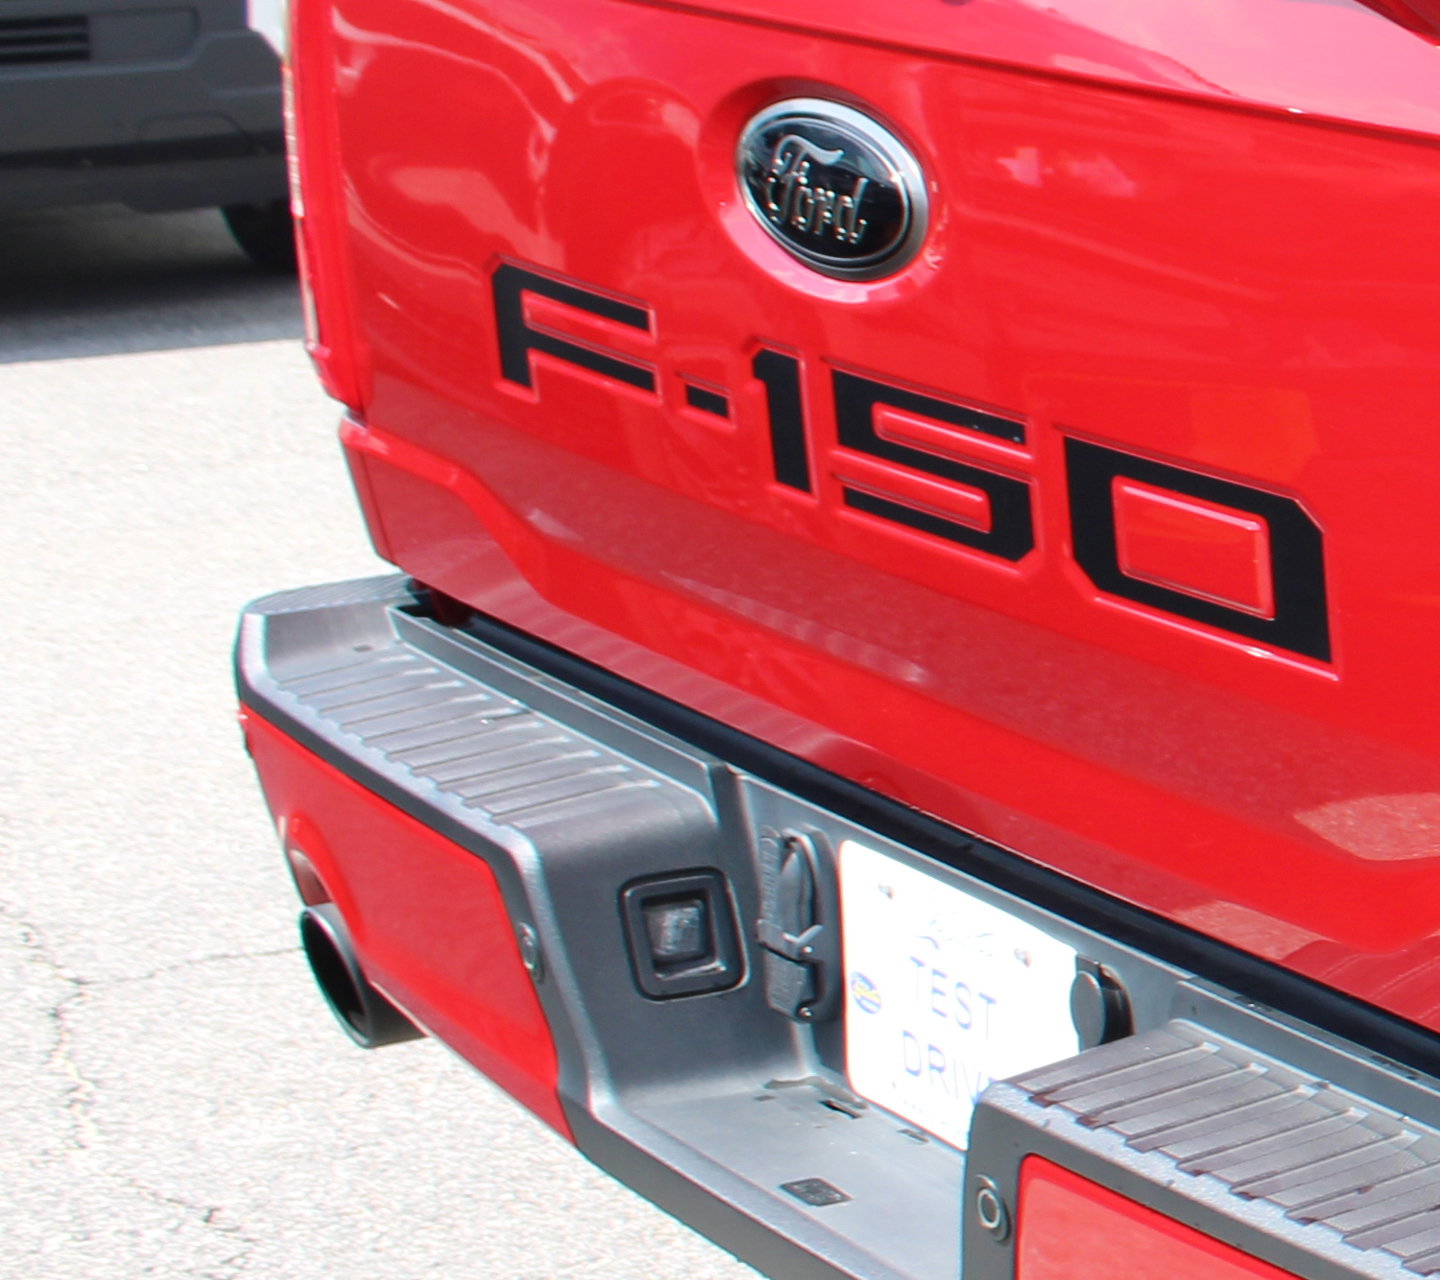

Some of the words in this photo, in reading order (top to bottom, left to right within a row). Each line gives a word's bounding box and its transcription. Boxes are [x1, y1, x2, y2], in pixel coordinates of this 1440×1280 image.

[766, 134, 868, 244] Ford
[490, 258, 1334, 667] F-150
[909, 955, 997, 1040] TEST
[902, 1029, 1000, 1106] DRIV
